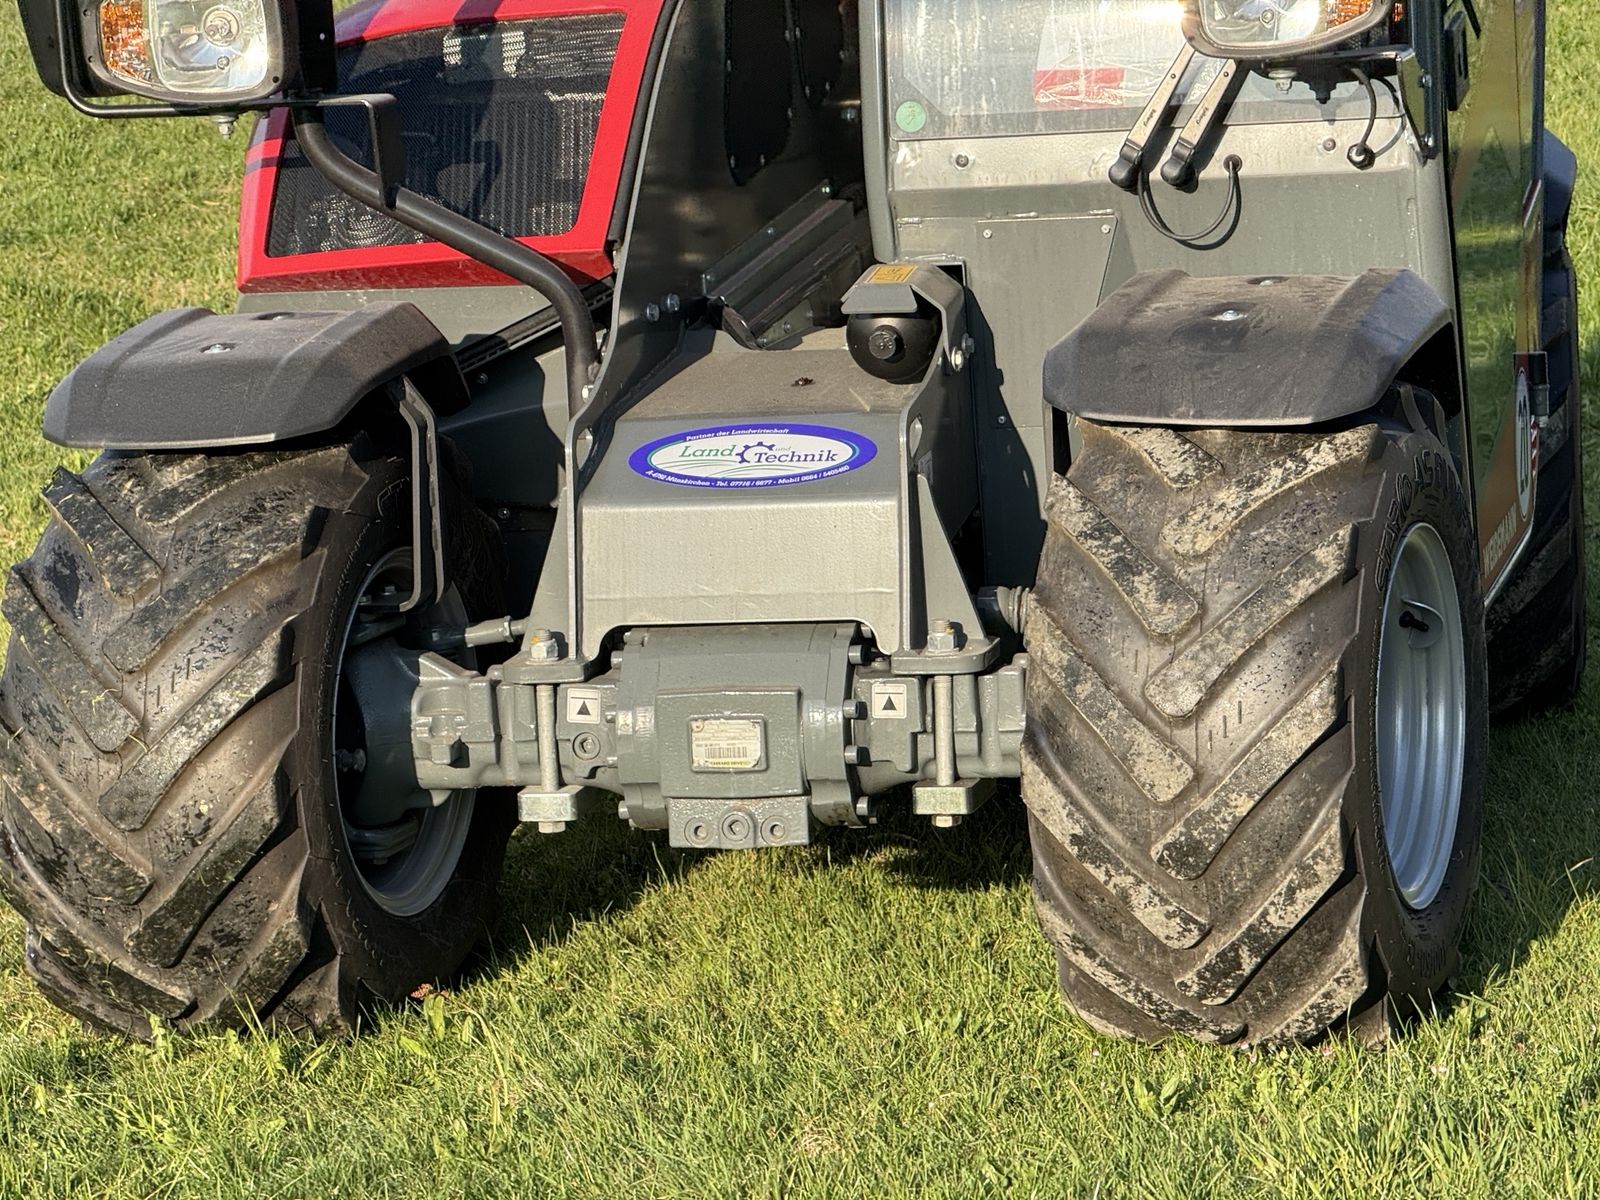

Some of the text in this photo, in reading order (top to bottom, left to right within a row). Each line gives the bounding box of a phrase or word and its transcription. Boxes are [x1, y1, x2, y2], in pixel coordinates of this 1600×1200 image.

[686, 433, 715, 441] Partner
[731, 427, 790, 435] Landwirtschaft
[678, 444, 737, 458] Land
[753, 450, 839, 463] Technik
[777, 476, 800, 485] Mobil
[801, 473, 818, 481] 0664
